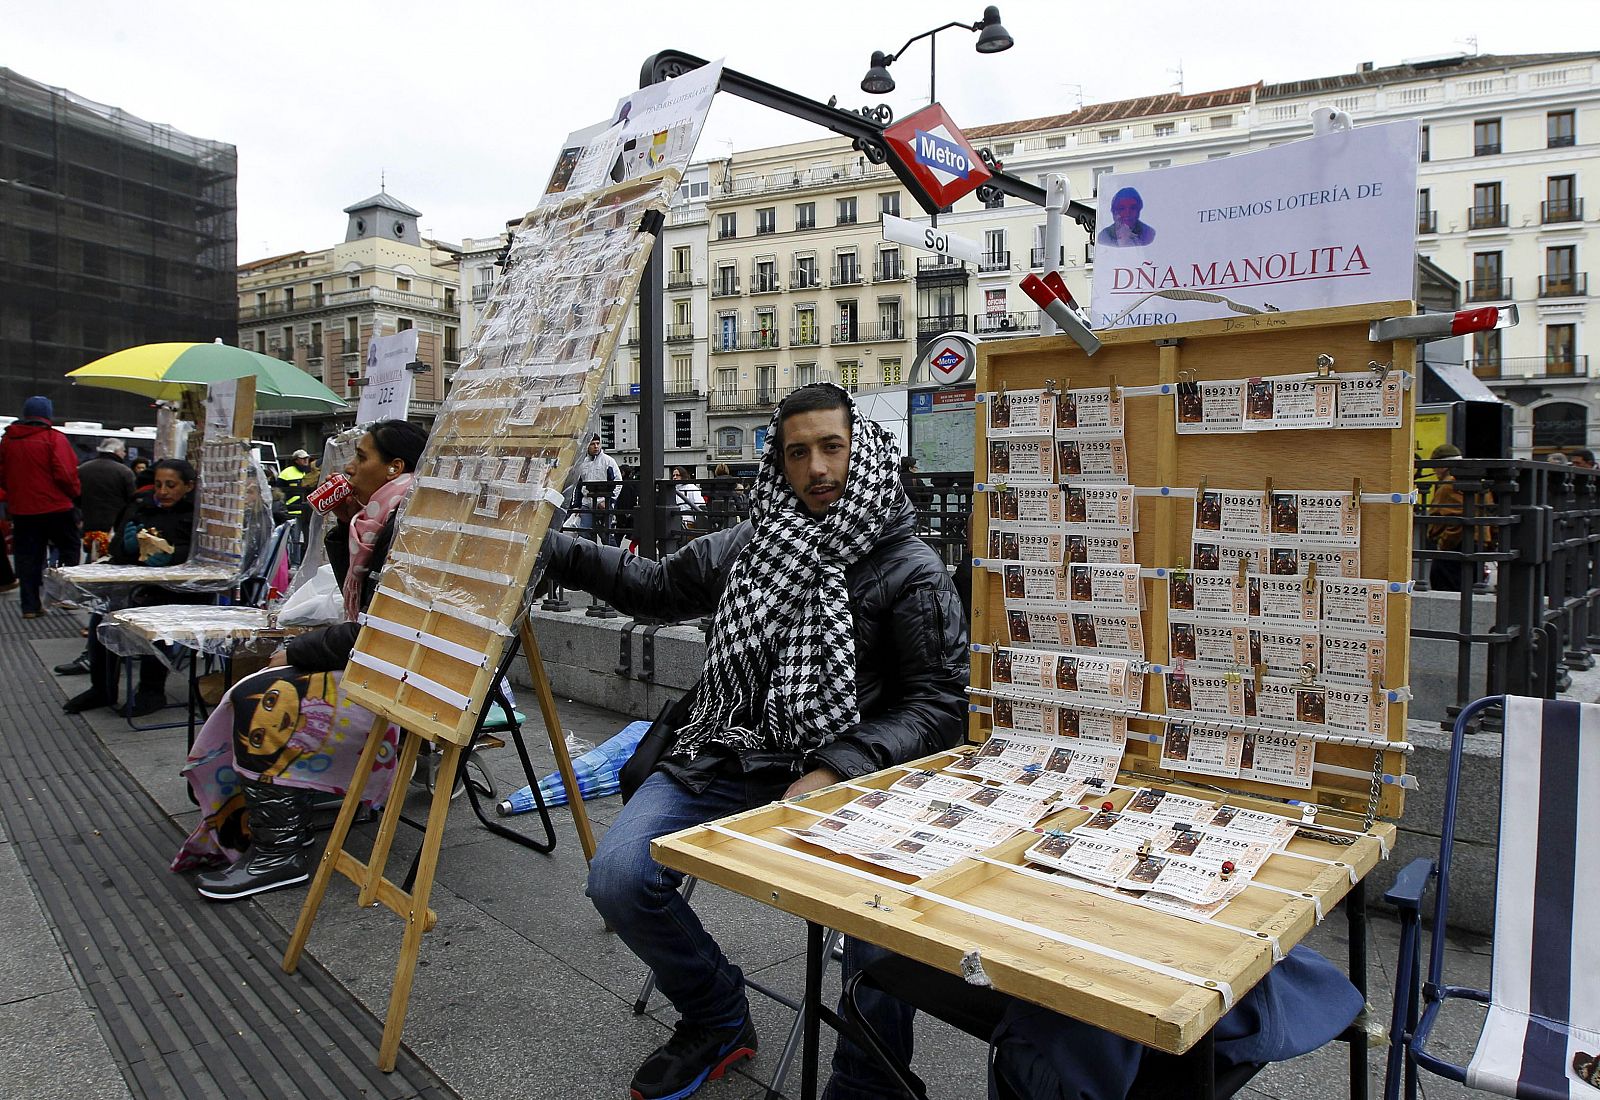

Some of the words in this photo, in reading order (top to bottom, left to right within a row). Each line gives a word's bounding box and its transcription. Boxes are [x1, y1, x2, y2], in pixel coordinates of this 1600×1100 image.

[921, 136, 965, 172] Metro
[1197, 201, 1271, 223] TENEMOS
[1277, 184, 1350, 210] LOTERÍA
[1356, 182, 1383, 199] DE
[925, 228, 948, 253] Sol
[938, 357, 957, 366] Metro
[1276, 381, 1316, 393] 98073
[1340, 379, 1383, 389] 81862
[1205, 387, 1241, 396] 89217
[1011, 395, 1040, 404] 63695
[1078, 394, 1109, 403] 72592
[1010, 443, 1039, 451] 63695
[1080, 442, 1111, 451] 72592
[1019, 490, 1048, 499] 59930
[1086, 490, 1118, 499] 59930
[1224, 496, 1261, 505] 80861
[1300, 497, 1341, 507] 82406
[1020, 536, 1049, 544] 59930
[1087, 538, 1118, 547] 59930
[1222, 548, 1259, 557] 80861
[1300, 552, 1341, 561] 82406
[1025, 568, 1055, 576] 79646
[1093, 569, 1124, 578] 79646
[1195, 576, 1231, 586] 05224
[1262, 581, 1301, 591] 81862
[1325, 584, 1367, 595] 05224
[1028, 613, 1057, 622] 79646
[1094, 617, 1126, 627] 79646
[1196, 627, 1233, 637] 05224
[1262, 634, 1301, 645] 81862
[1325, 639, 1367, 650] 05224
[1013, 654, 1041, 664] 47751
[1079, 661, 1109, 671] 47751
[1191, 677, 1228, 687] 85809
[1264, 683, 1295, 694] 2406
[1327, 690, 1369, 703] 98073
[1193, 727, 1229, 738] 85809
[1257, 735, 1297, 746] 82406
[1008, 743, 1037, 753] 47751
[1073, 753, 1105, 764] 47751
[1165, 797, 1204, 808] 85809
[1123, 816, 1163, 830] 80861
[1206, 835, 1249, 848] 82406
[1079, 840, 1121, 854] 98073
[1170, 860, 1217, 877] 86418
